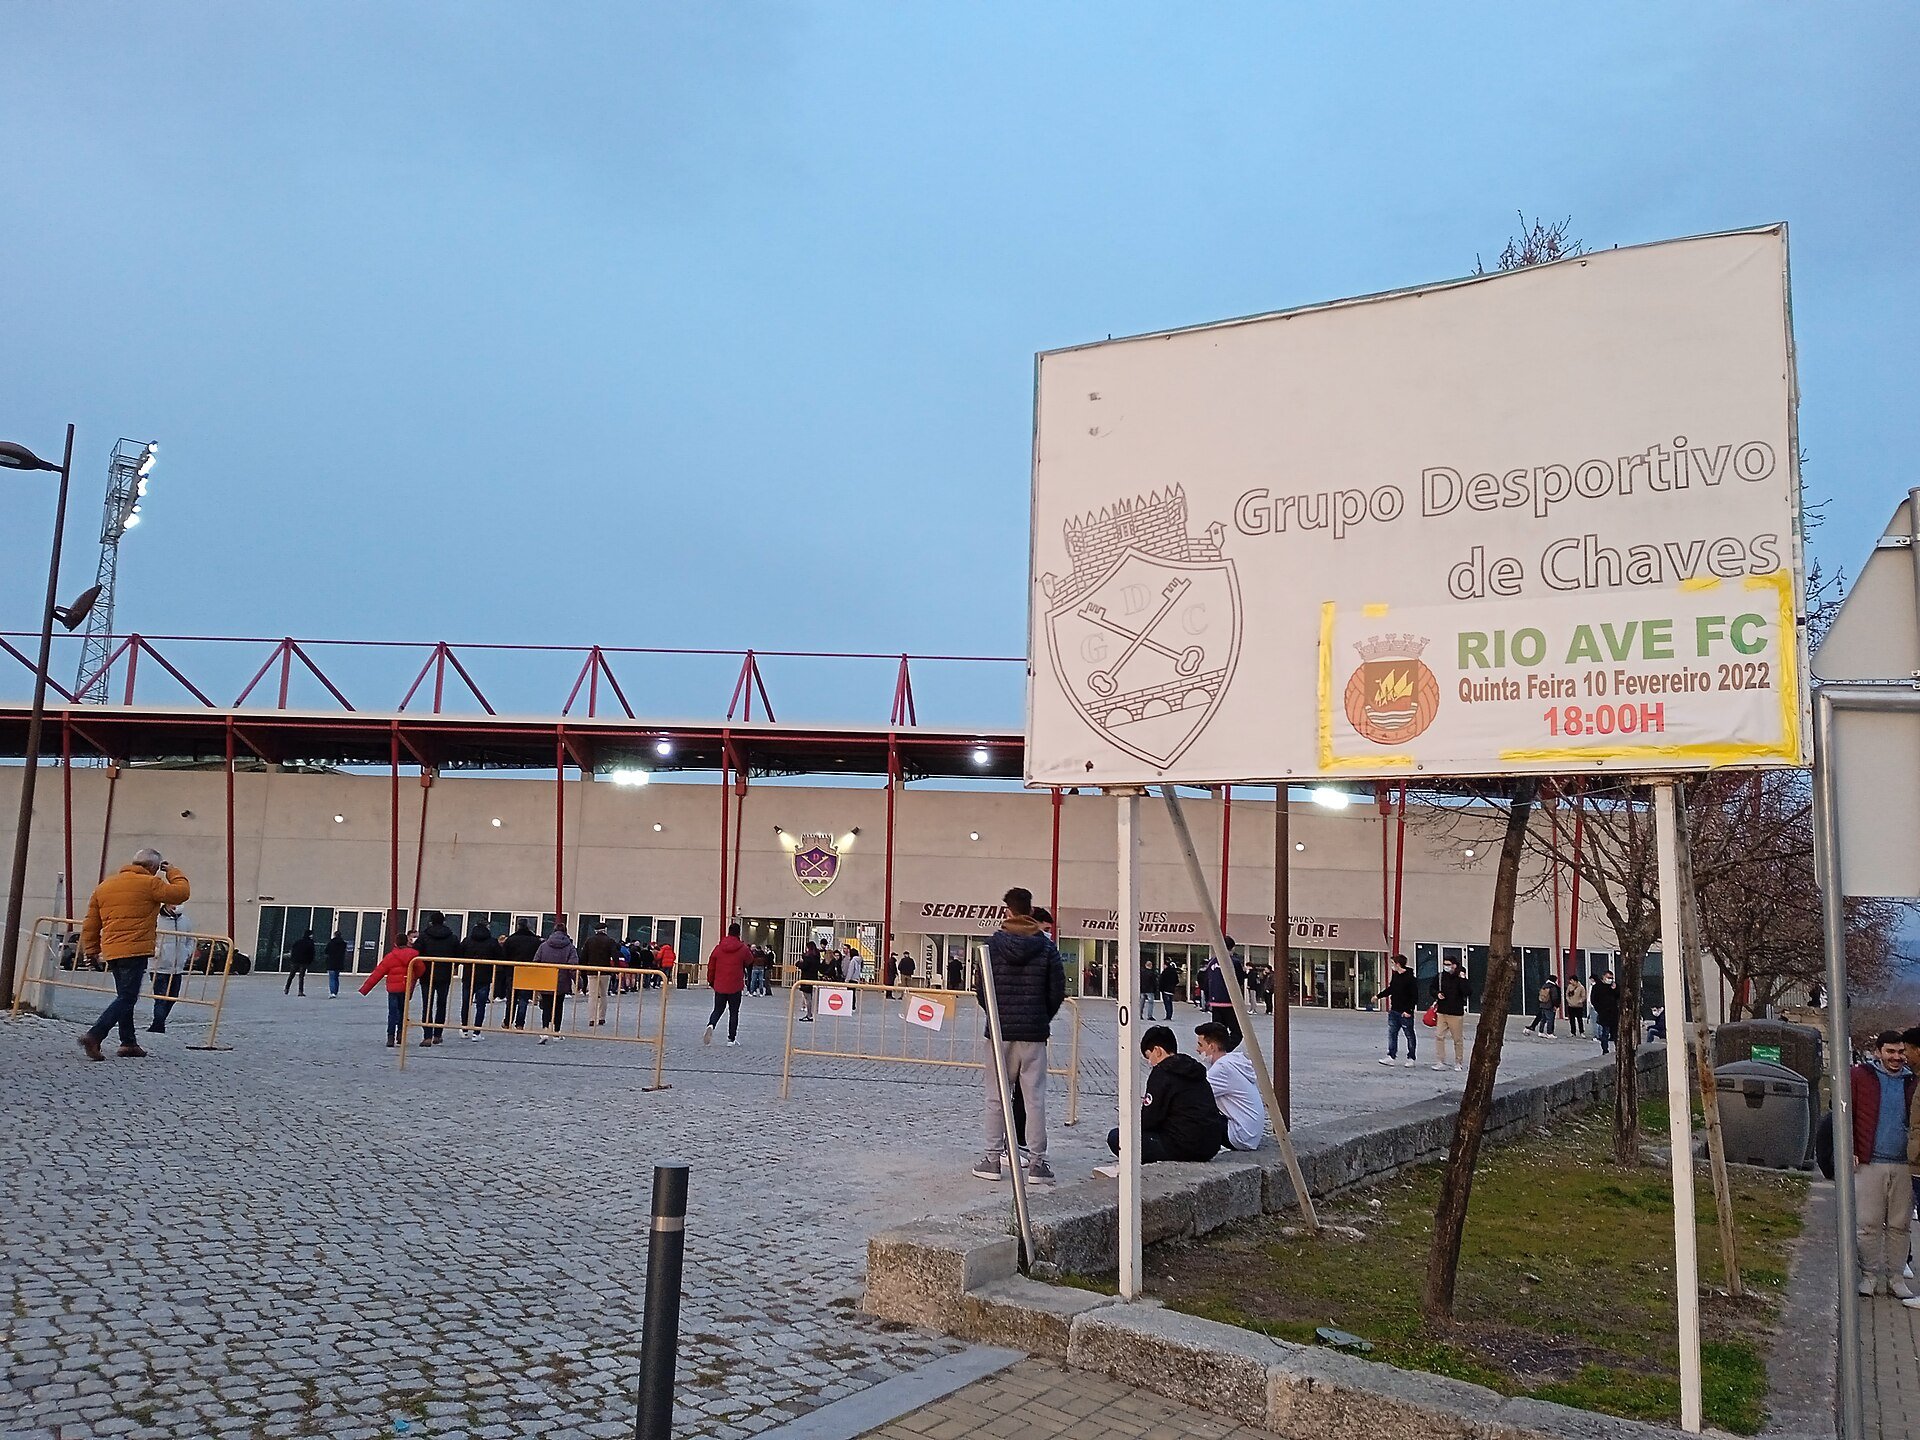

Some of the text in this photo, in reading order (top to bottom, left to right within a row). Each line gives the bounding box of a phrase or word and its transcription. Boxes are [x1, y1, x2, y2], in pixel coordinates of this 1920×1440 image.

[1234, 435, 1777, 540] Grupo Desportivo
[1448, 534, 1781, 600] de Chaves
[1120, 583, 1151, 616] D
[1182, 603, 1208, 635] C
[1080, 633, 1108, 664] G
[1458, 614, 1768, 669] RIO AVE FC
[1458, 662, 1770, 704] Quinta Feira 10 Fevereiro 2022
[1543, 702, 1665, 737] 18:00H
[921, 903, 1008, 919] SECRETAR
